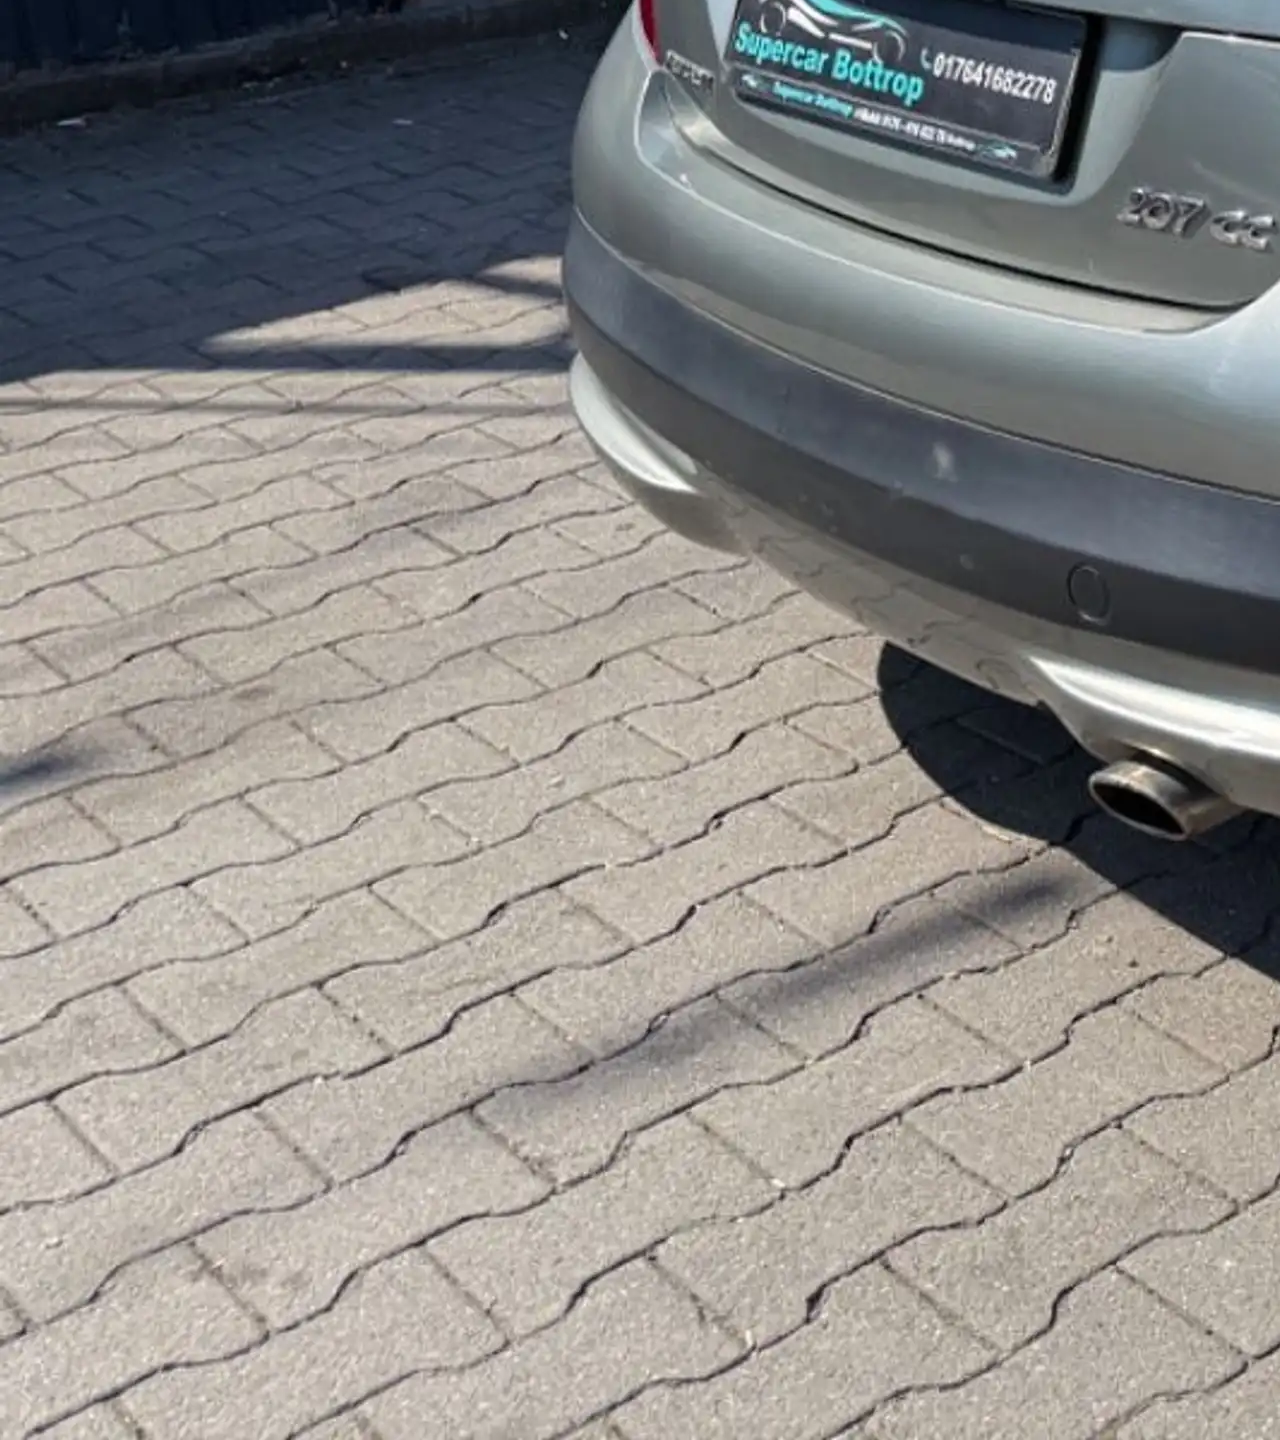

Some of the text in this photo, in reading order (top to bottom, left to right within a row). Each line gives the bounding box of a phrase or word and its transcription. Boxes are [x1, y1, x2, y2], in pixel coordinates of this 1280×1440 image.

[734, 21, 829, 74] Supercar
[831, 48, 923, 108] Bottrop
[932, 51, 1058, 105] 017641682278
[1116, 187, 1278, 252] 207 CC
